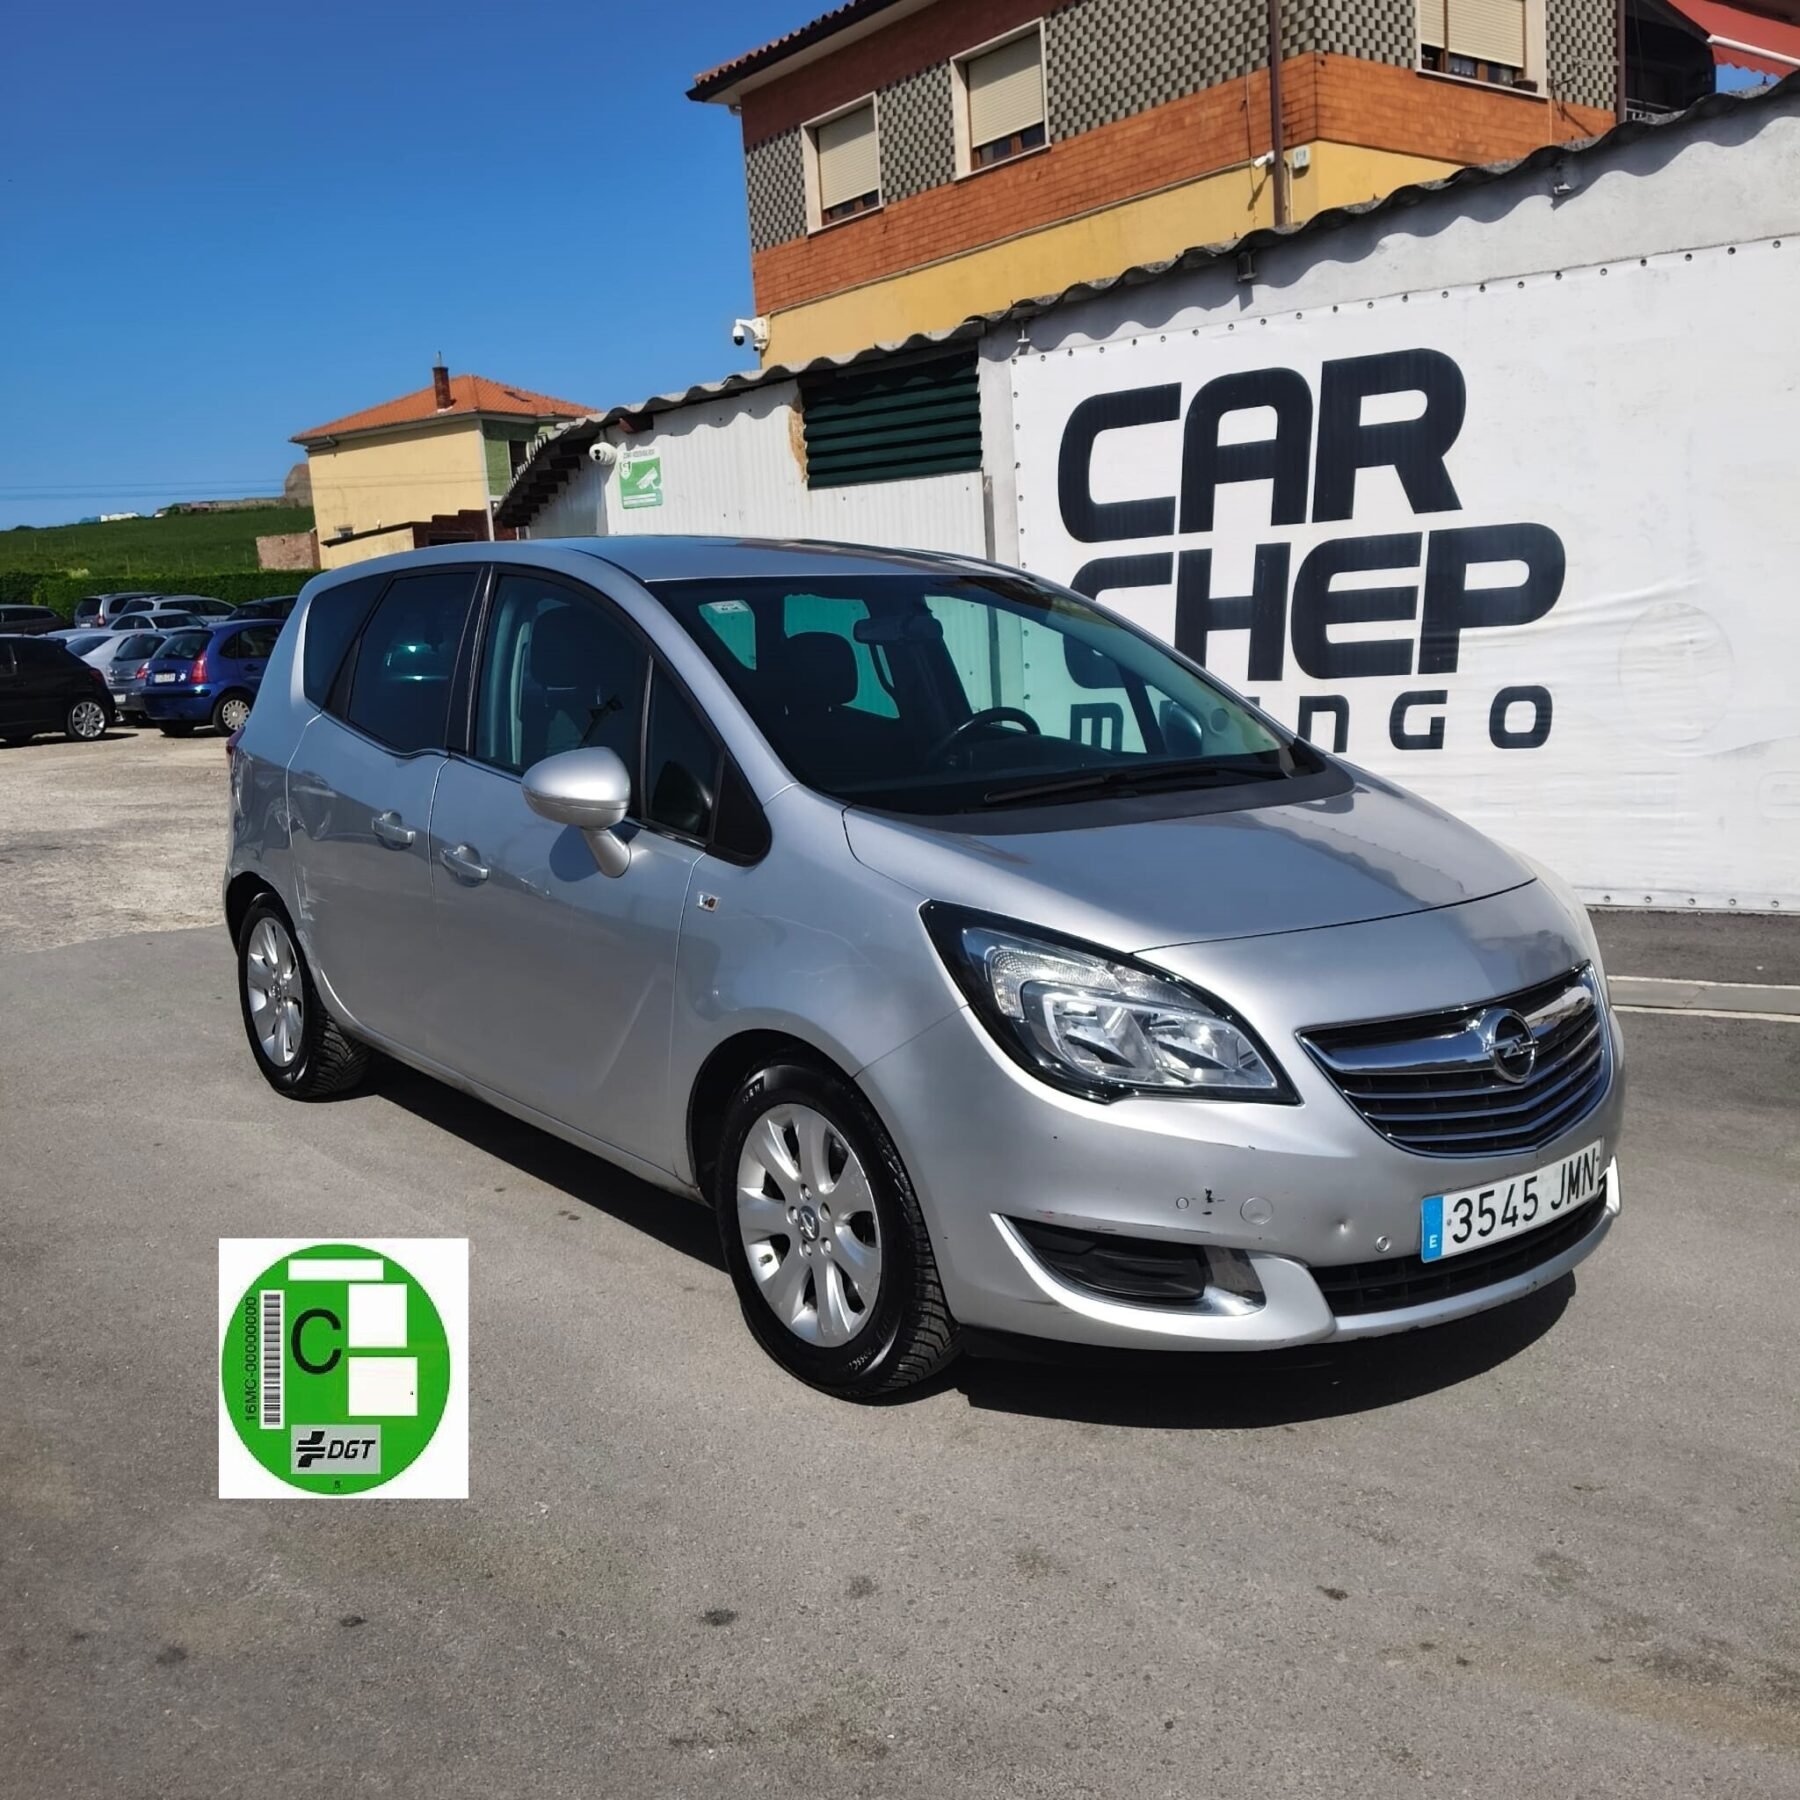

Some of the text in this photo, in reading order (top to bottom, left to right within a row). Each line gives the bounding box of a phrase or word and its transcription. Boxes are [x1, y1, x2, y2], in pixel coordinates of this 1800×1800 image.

[1058, 348, 1467, 544] CAR
[1063, 522, 1567, 690] CHEP
[1429, 1234, 1438, 1249] E
[1452, 1147, 1597, 1244] 3545 JMN
